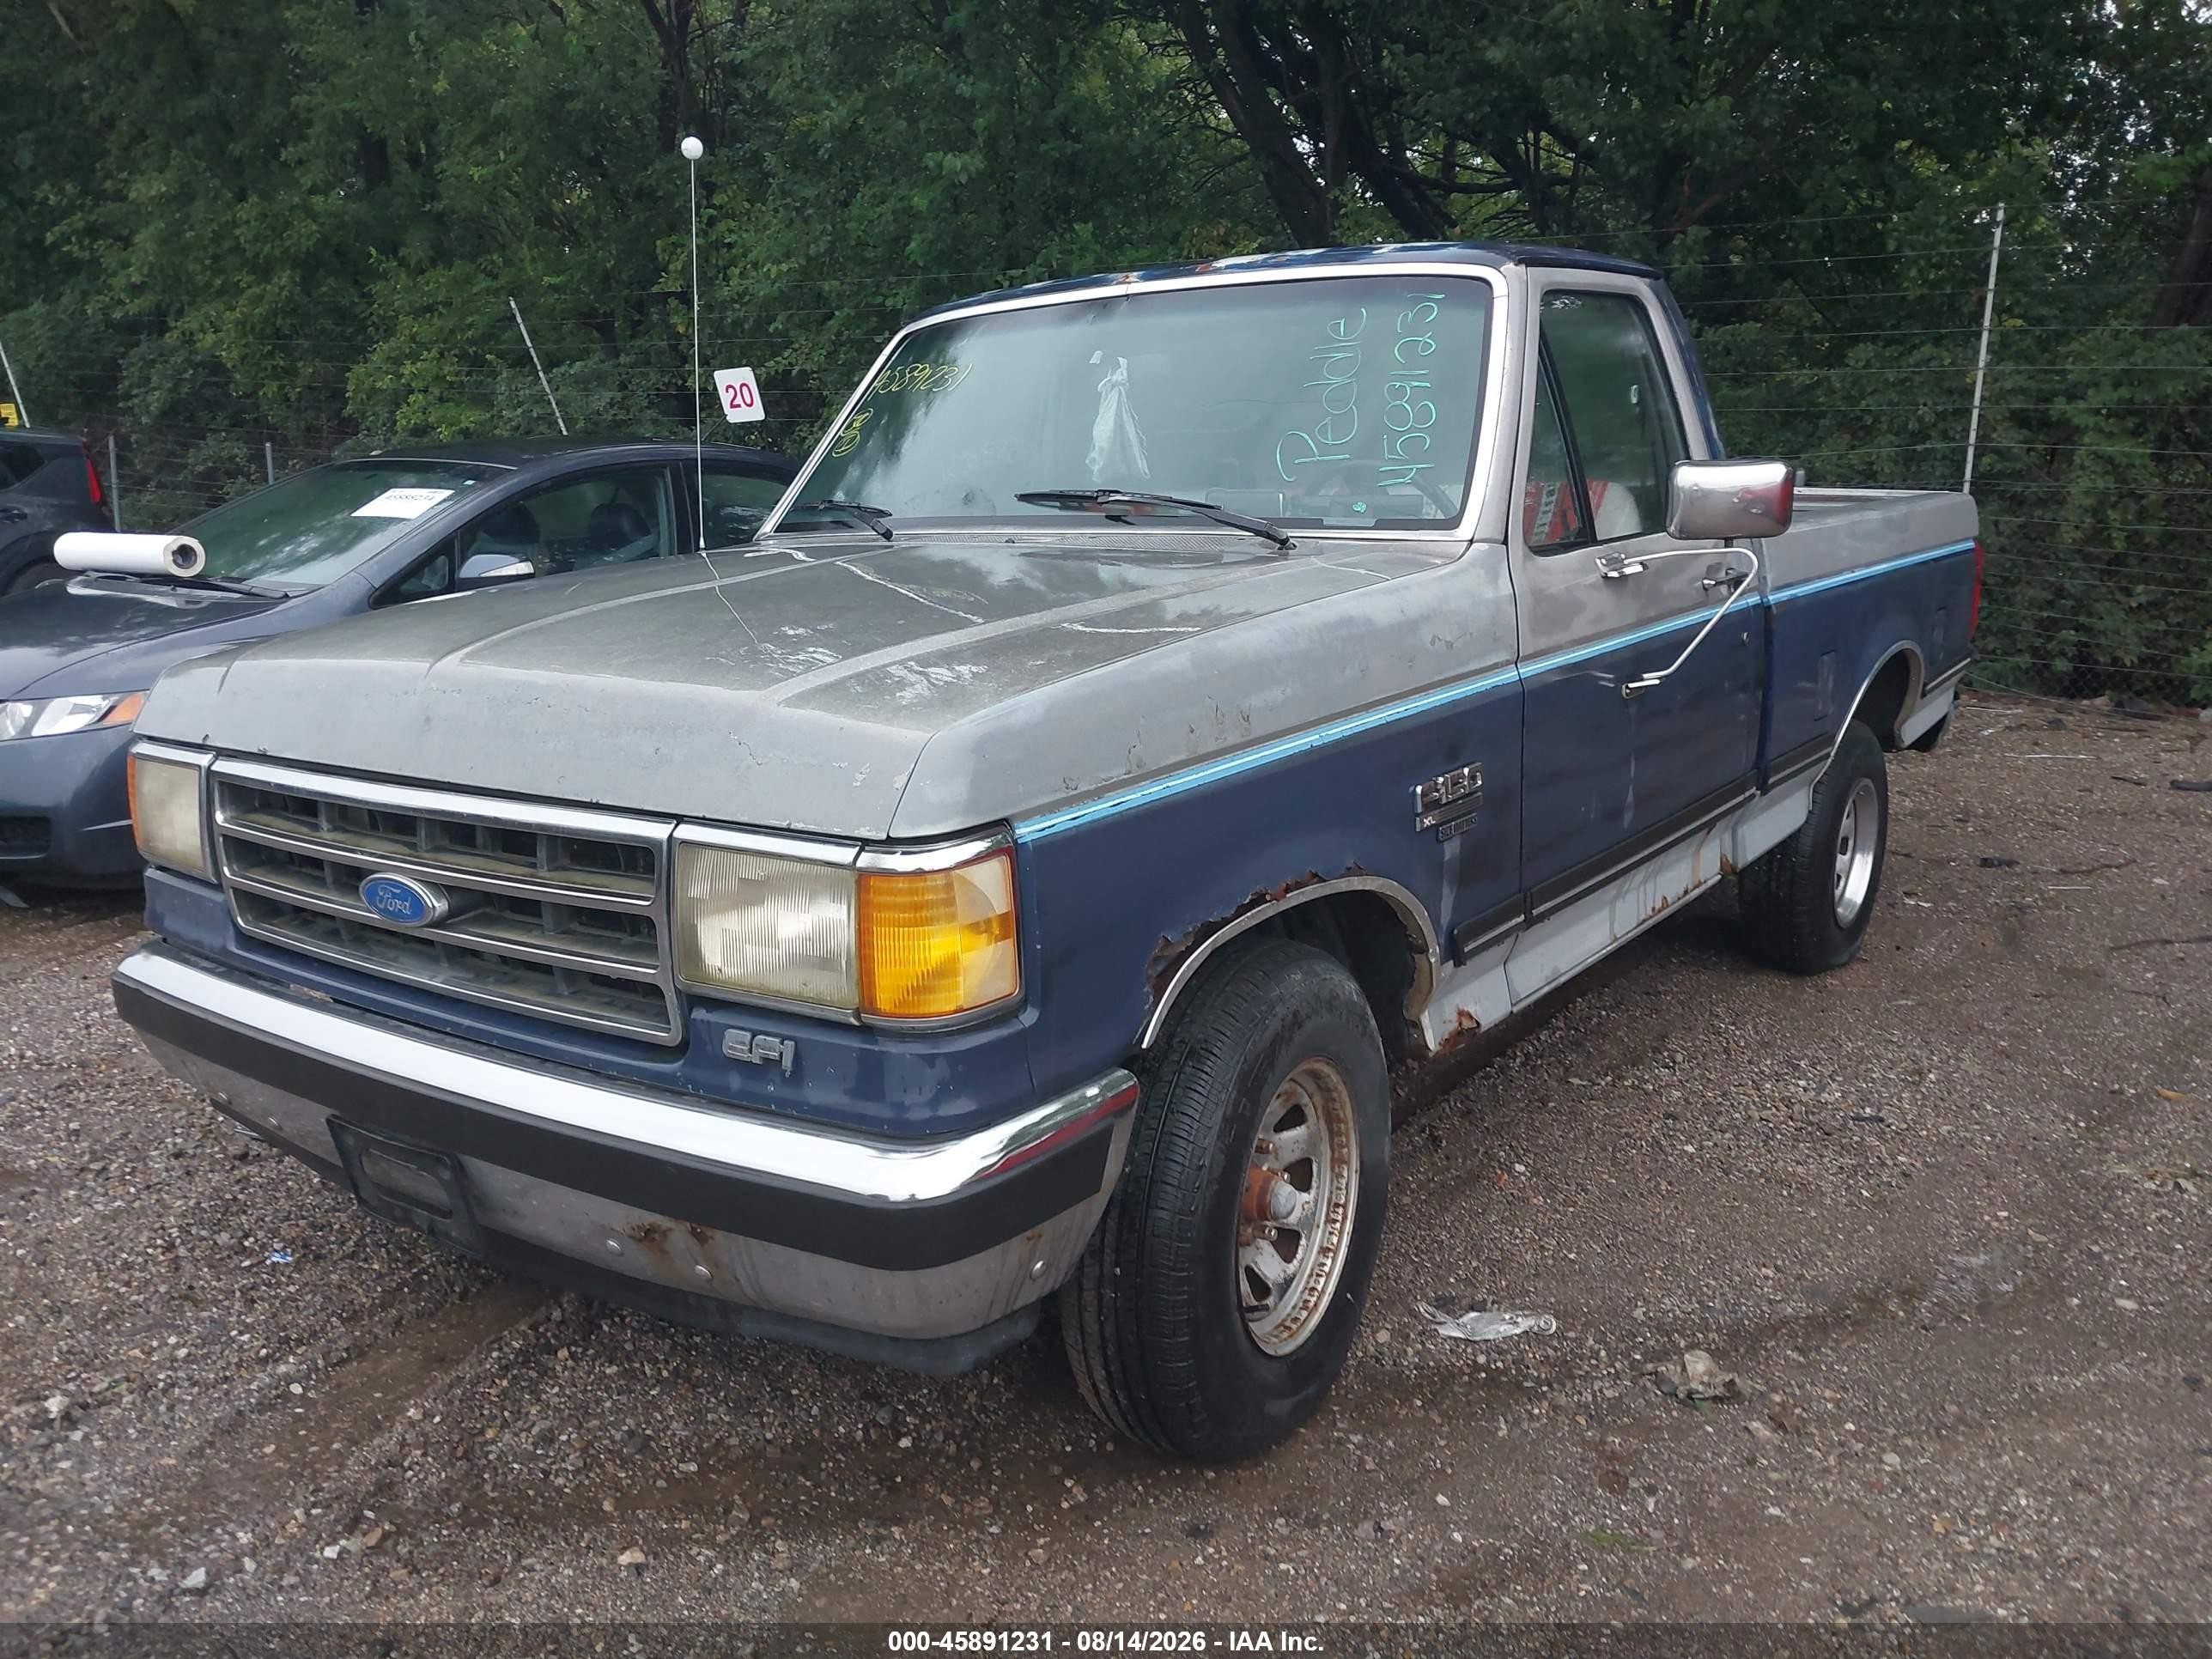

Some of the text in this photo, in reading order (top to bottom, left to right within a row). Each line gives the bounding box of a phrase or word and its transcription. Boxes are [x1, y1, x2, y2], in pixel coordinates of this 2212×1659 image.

[725, 382, 754, 409] 20
[1276, 307, 1367, 482] Peddle
[1376, 293, 1446, 487] 45891231
[376, 884, 413, 915] Ford
[722, 1029, 795, 1072] EFI
